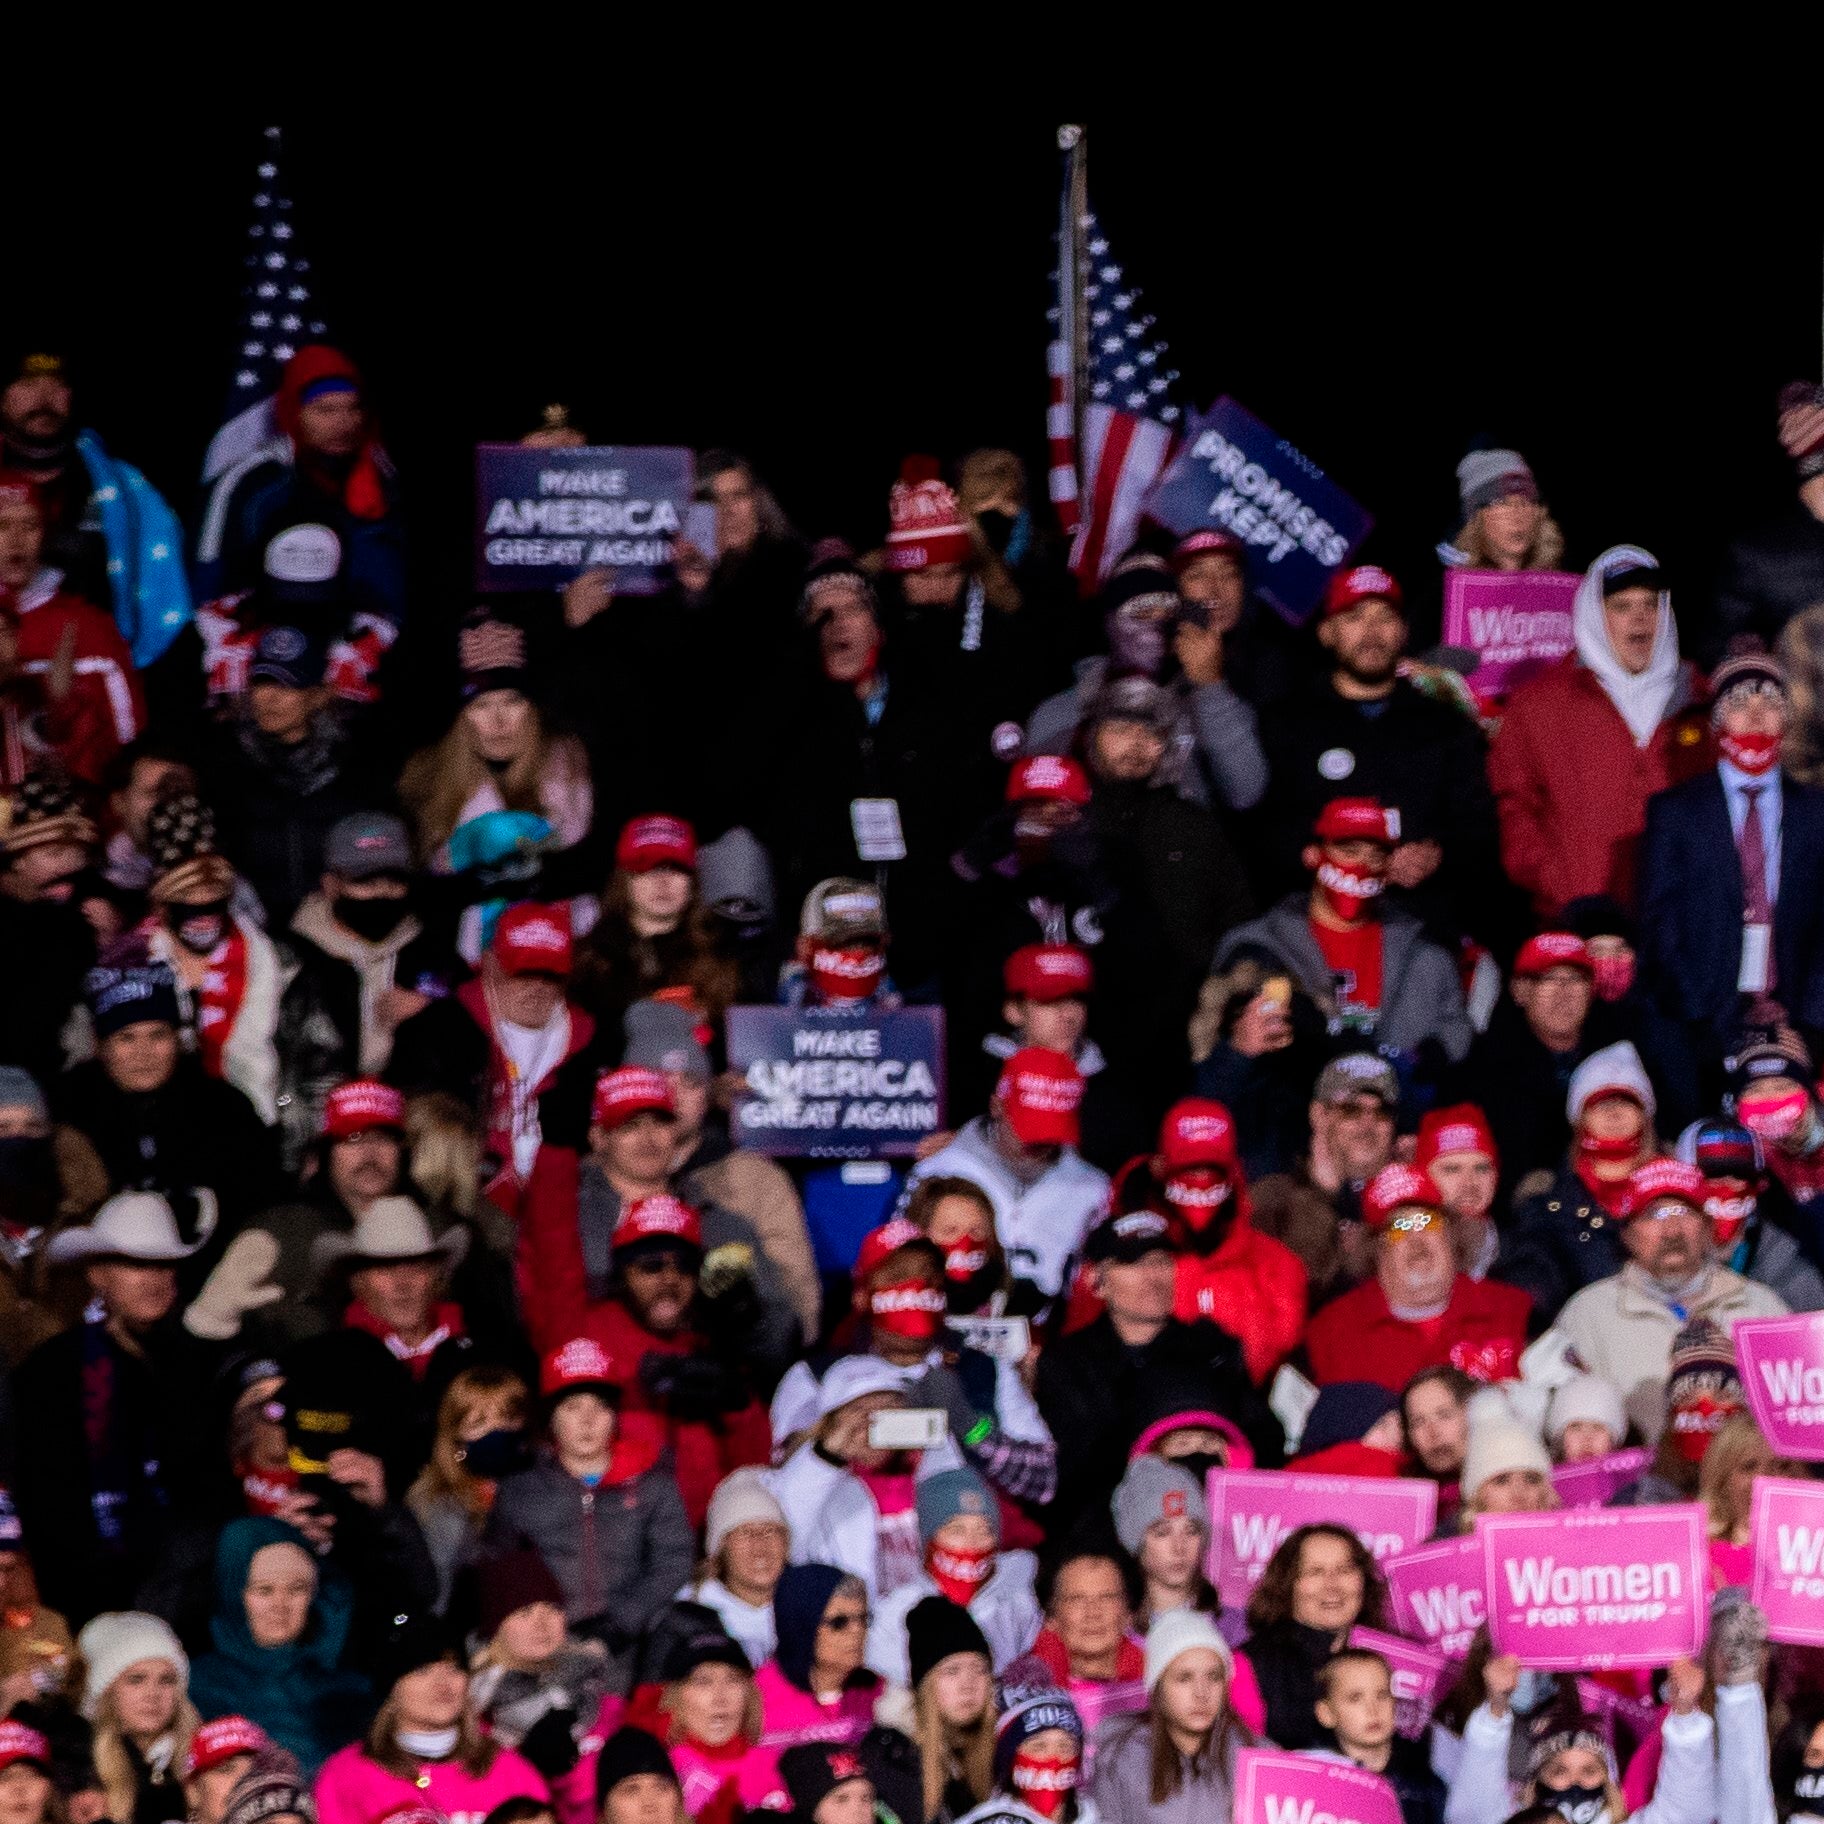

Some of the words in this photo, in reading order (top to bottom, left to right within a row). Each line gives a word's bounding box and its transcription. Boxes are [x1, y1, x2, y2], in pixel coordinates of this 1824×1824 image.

[539, 470, 628, 495] MAKE
[1190, 430, 1348, 565] PROMISES
[485, 497, 679, 535] AMERICA
[1209, 488, 1300, 562] KEPT
[485, 540, 582, 564] GREAT
[793, 1028, 881, 1057] MAKE
[747, 1059, 935, 1097] AMERICA
[739, 1099, 837, 1131] GREAT
[842, 1100, 937, 1129] AGAIN
[1505, 1558, 1681, 1605] Women
[1527, 1605, 1576, 1628] FOR
[1586, 1601, 1663, 1625] TRUMP
